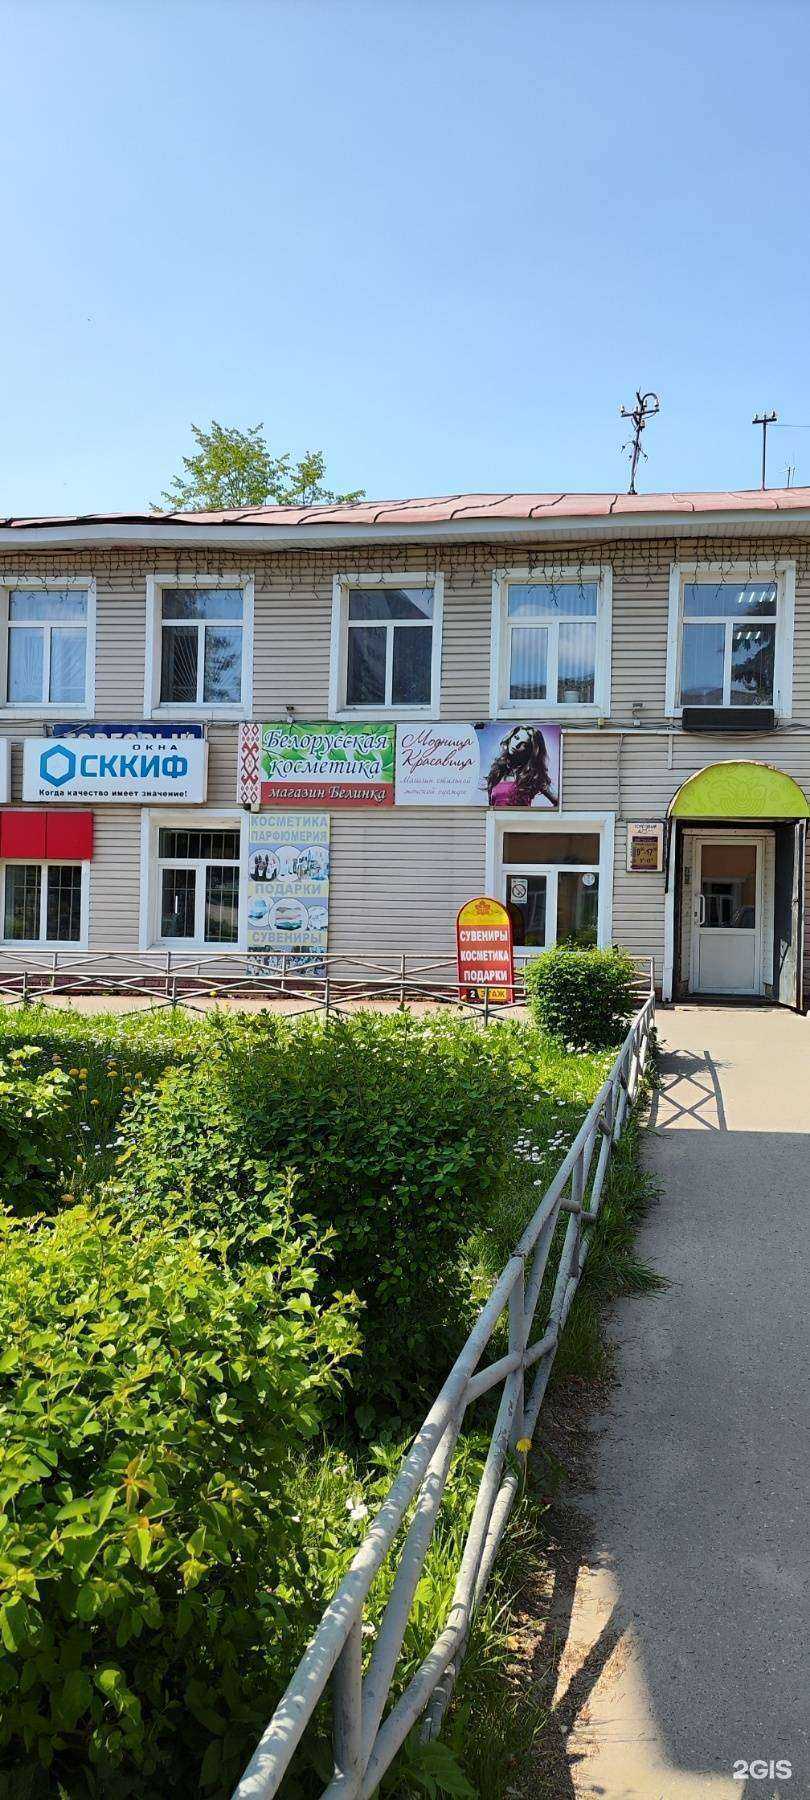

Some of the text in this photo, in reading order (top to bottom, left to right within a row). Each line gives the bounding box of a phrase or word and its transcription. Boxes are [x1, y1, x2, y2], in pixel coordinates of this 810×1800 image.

[264, 728, 388, 756] Белорусская
[401, 729, 474, 751] Модница
[80, 754, 188, 779] СККИФ
[401, 748, 475, 773] Красавица
[270, 759, 380, 779] косметика
[39, 789, 64, 797] Когда
[67, 789, 108, 797] качество
[142, 789, 188, 797] значение!
[269, 786, 386, 802] магазин Белинка
[251, 816, 328, 827] КОСМЕТИКА
[251, 830, 327, 842] ПАРФЮМЕРИЯ
[255, 883, 321, 896] ПОДАРКИ
[252, 931, 322, 944] СУВЕНИРЫ
[460, 930, 508, 942] СУВЕНИРЫ
[460, 950, 509, 962] КОСМЕТИКА
[463, 970, 508, 984] ПОДАРКИ
[469, 990, 476, 998] 2
